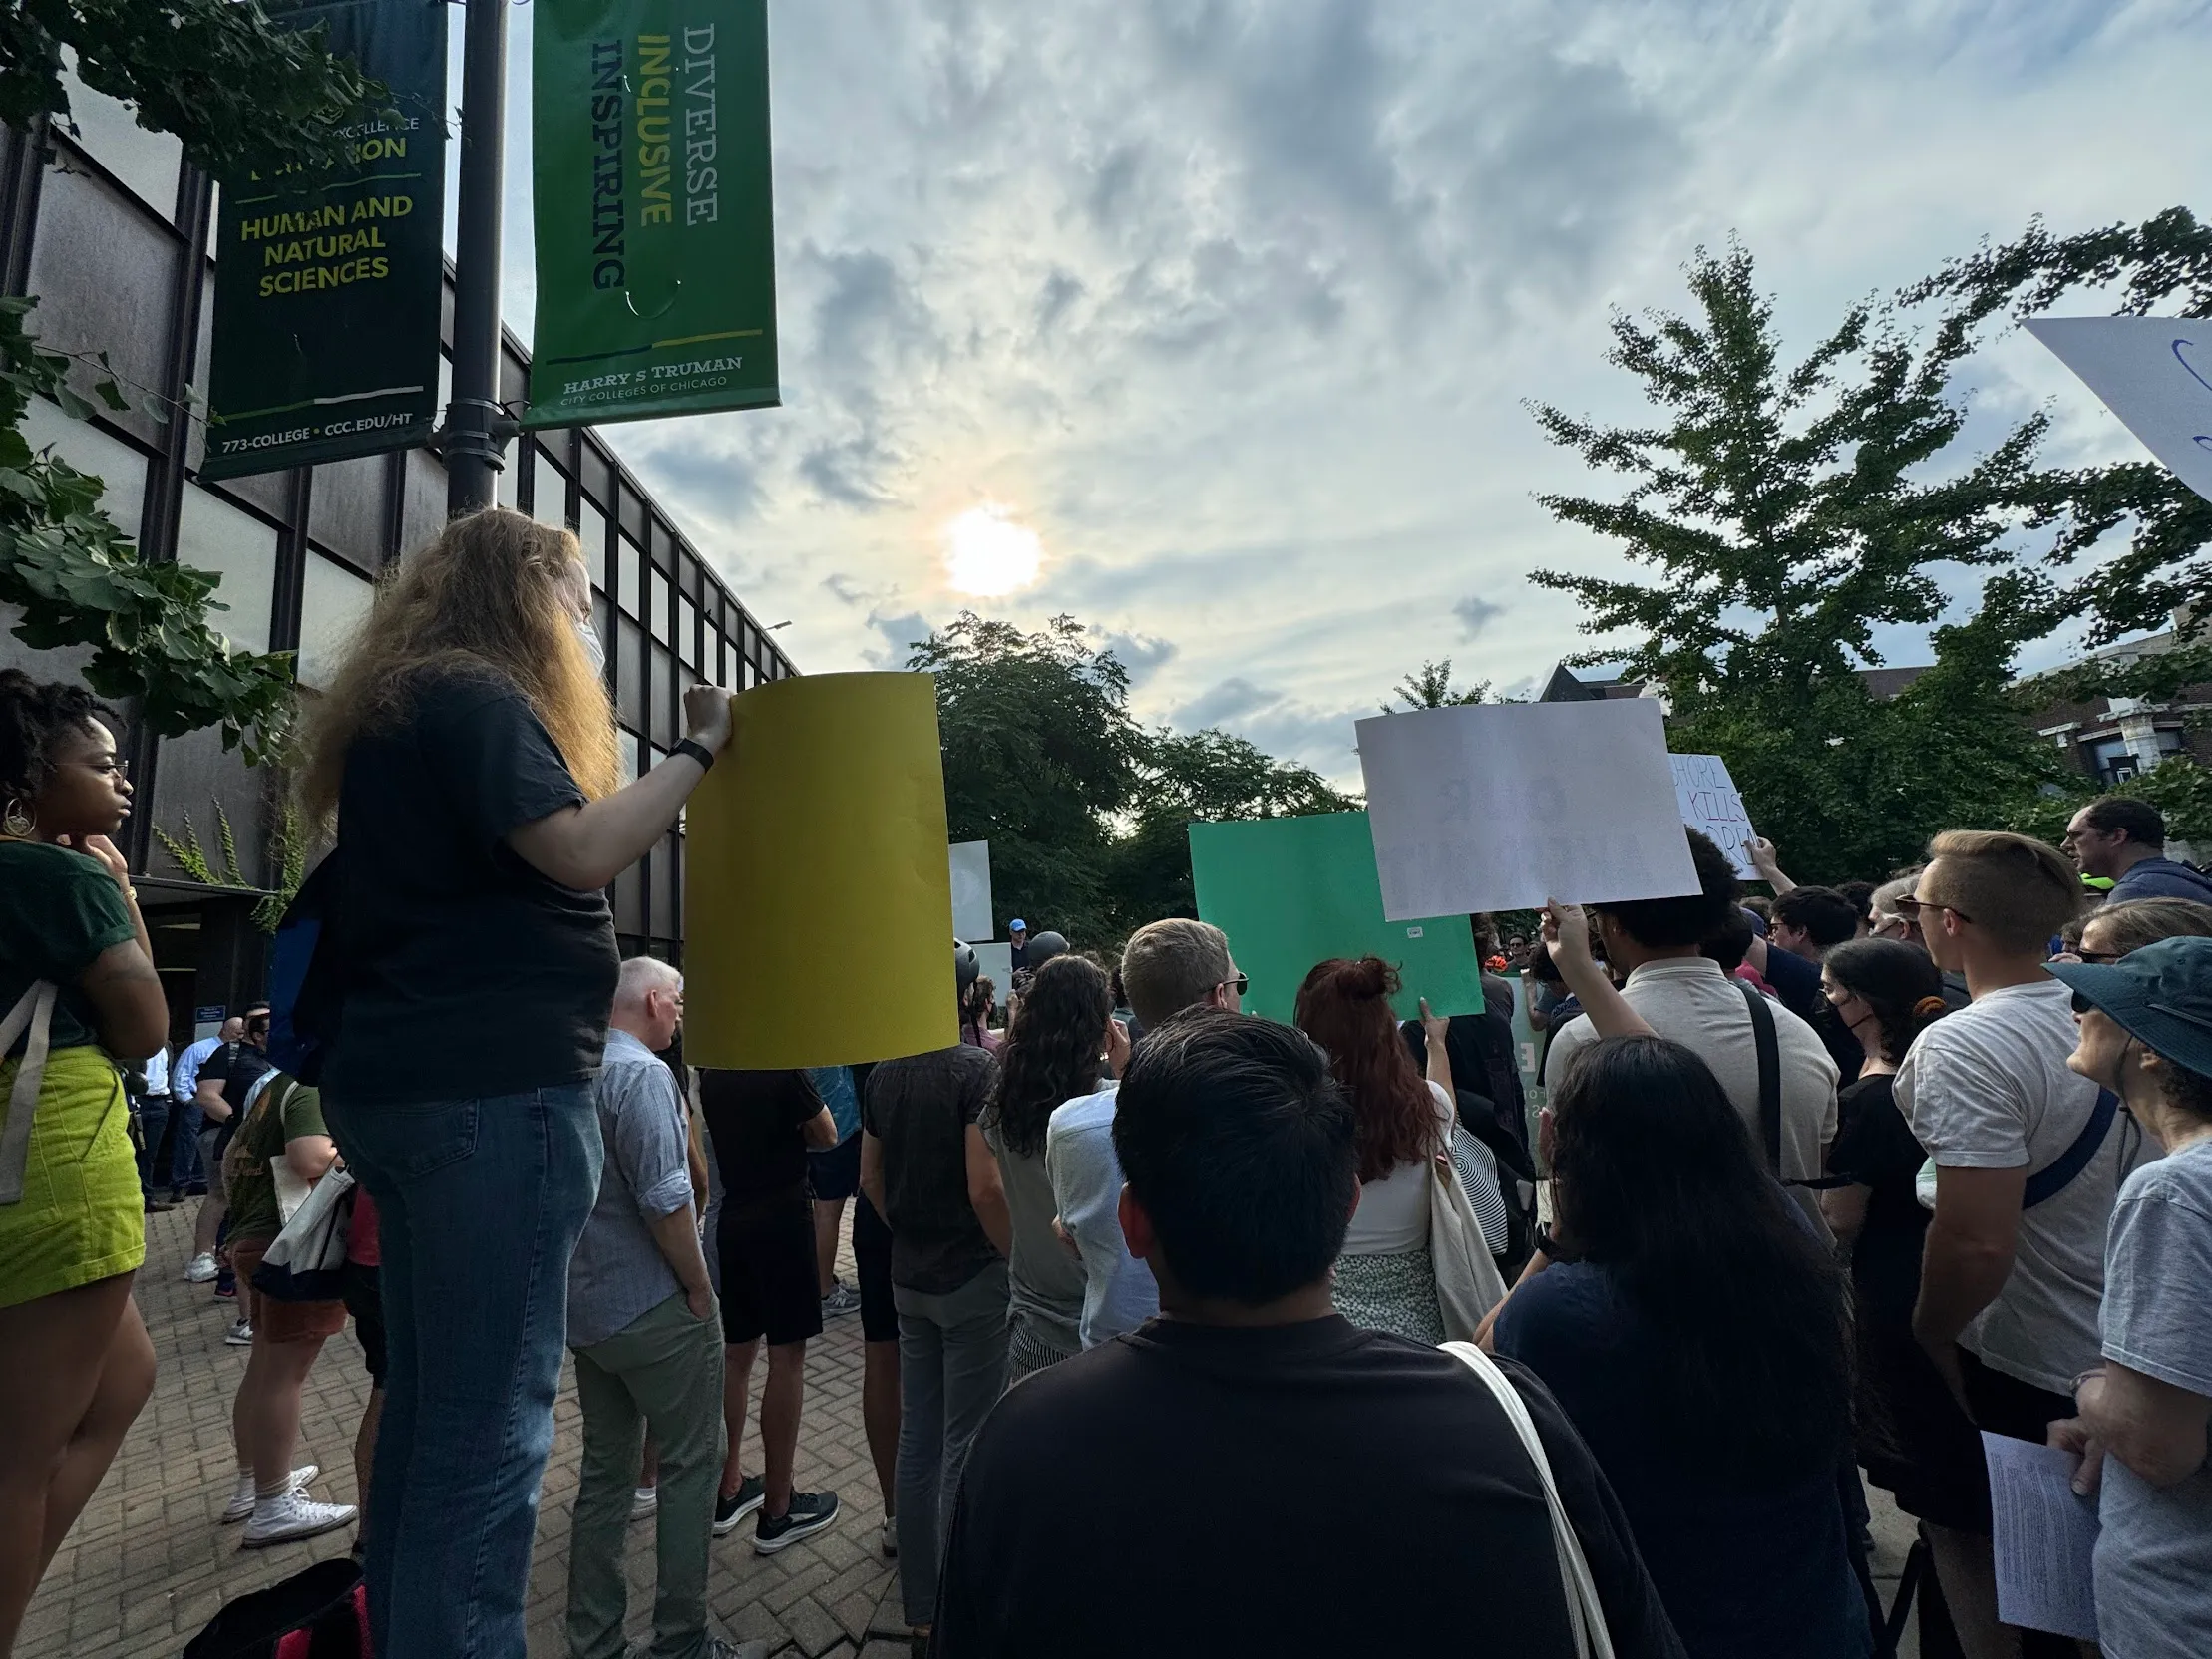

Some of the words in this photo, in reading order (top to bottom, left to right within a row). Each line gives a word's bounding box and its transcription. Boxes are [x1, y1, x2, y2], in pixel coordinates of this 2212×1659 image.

[637, 35, 672, 227] INCLUSIVE
[684, 23, 718, 226] DIVERSE
[591, 39, 625, 290] INSPIRING
[240, 205, 345, 241] HUMAN
[351, 196, 413, 223] AND
[264, 226, 386, 267] NATURAL
[259, 257, 389, 297] SCIENCES
[560, 395, 586, 406] CITY
[589, 385, 646, 402] COLLEGES
[650, 383, 666, 393] OF
[670, 376, 727, 392] CHICAGO
[563, 373, 631, 395] HARRY
[636, 370, 646, 382] S
[651, 357, 742, 379] TRUMAN
[222, 427, 310, 453] 773-COLLEGE
[324, 413, 413, 437] CCC.EDU/HT
[1672, 755, 1727, 789] HORE
[1687, 791, 1746, 822] KILLS
